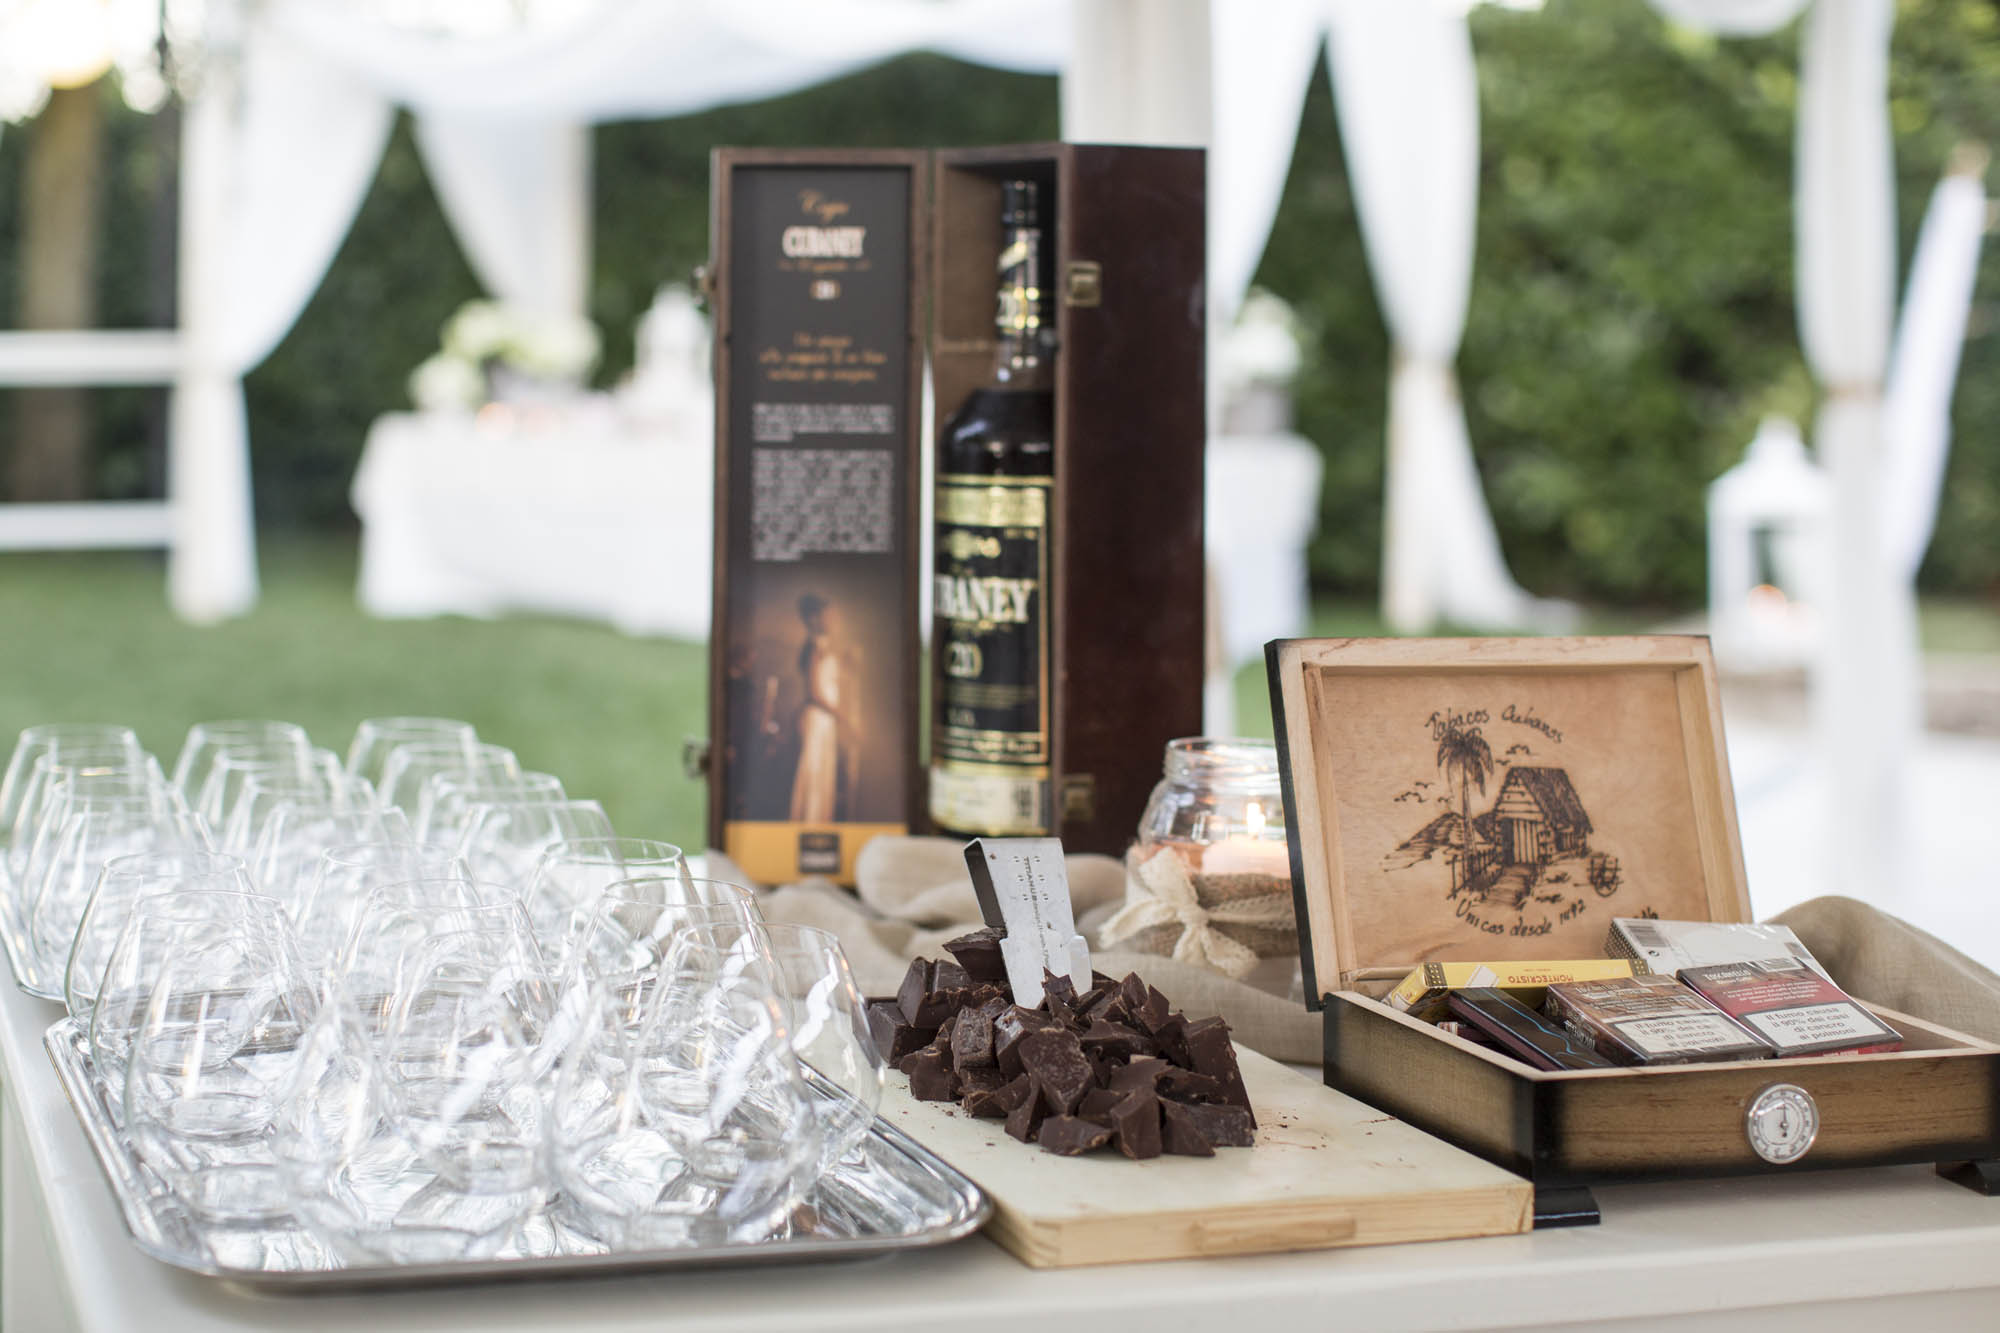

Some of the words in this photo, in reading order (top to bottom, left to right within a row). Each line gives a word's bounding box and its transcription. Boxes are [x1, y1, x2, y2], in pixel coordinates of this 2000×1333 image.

[1424, 708, 1490, 741] Tabacos
[1776, 1009, 1802, 1020] fumo
[1805, 1006, 1840, 1017] causa
[1781, 1017, 1804, 1027] 90%
[1807, 1013, 1824, 1023] dei
[1827, 1011, 1850, 1022] casi
[1644, 1019, 1674, 1030] fumo
[1794, 1023, 1805, 1033] di
[1807, 1020, 1846, 1032] cancro
[1663, 1033, 1675, 1042] di
[1799, 1032, 1810, 1041] ai
[1811, 1027, 1857, 1042] polmoni
